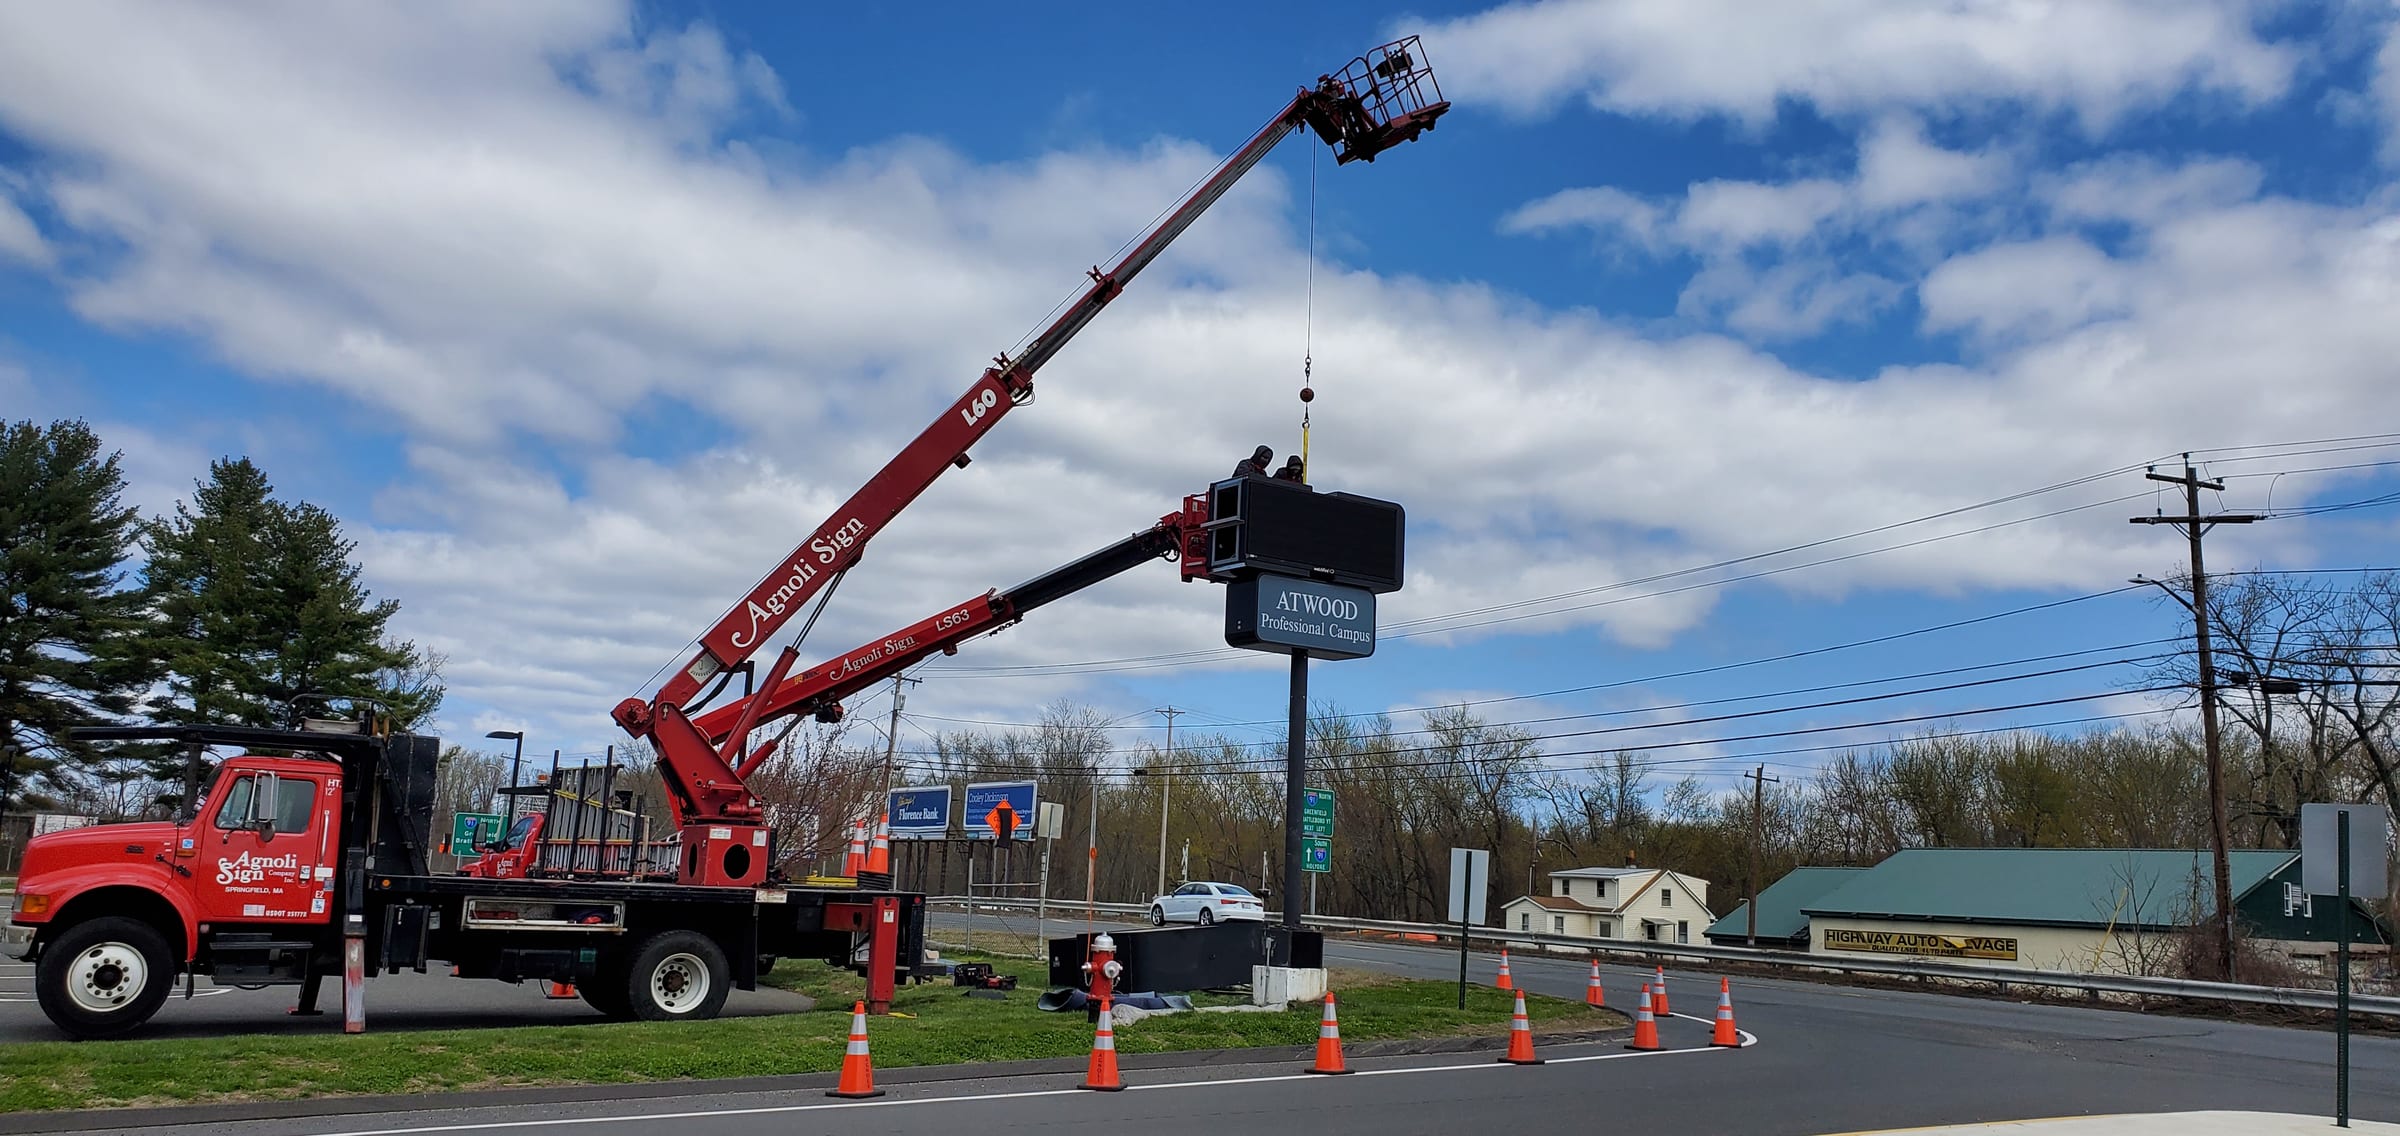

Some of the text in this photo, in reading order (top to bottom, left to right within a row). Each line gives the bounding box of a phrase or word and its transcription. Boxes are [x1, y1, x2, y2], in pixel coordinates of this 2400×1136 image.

[961, 389, 997, 427] L60
[731, 517, 865, 649] Agnoli Sign
[1276, 591, 1358, 620] ATWOOD
[935, 609, 970, 631] LS63
[1261, 613, 1371, 644] Professional Campus
[829, 634, 915, 681] Agnoli Sign
[898, 807, 939, 821] Florence Bank
[218, 851, 297, 870] Agnoli
[216, 863, 264, 885] Sign
[1897, 934, 1939, 948] AUTO
